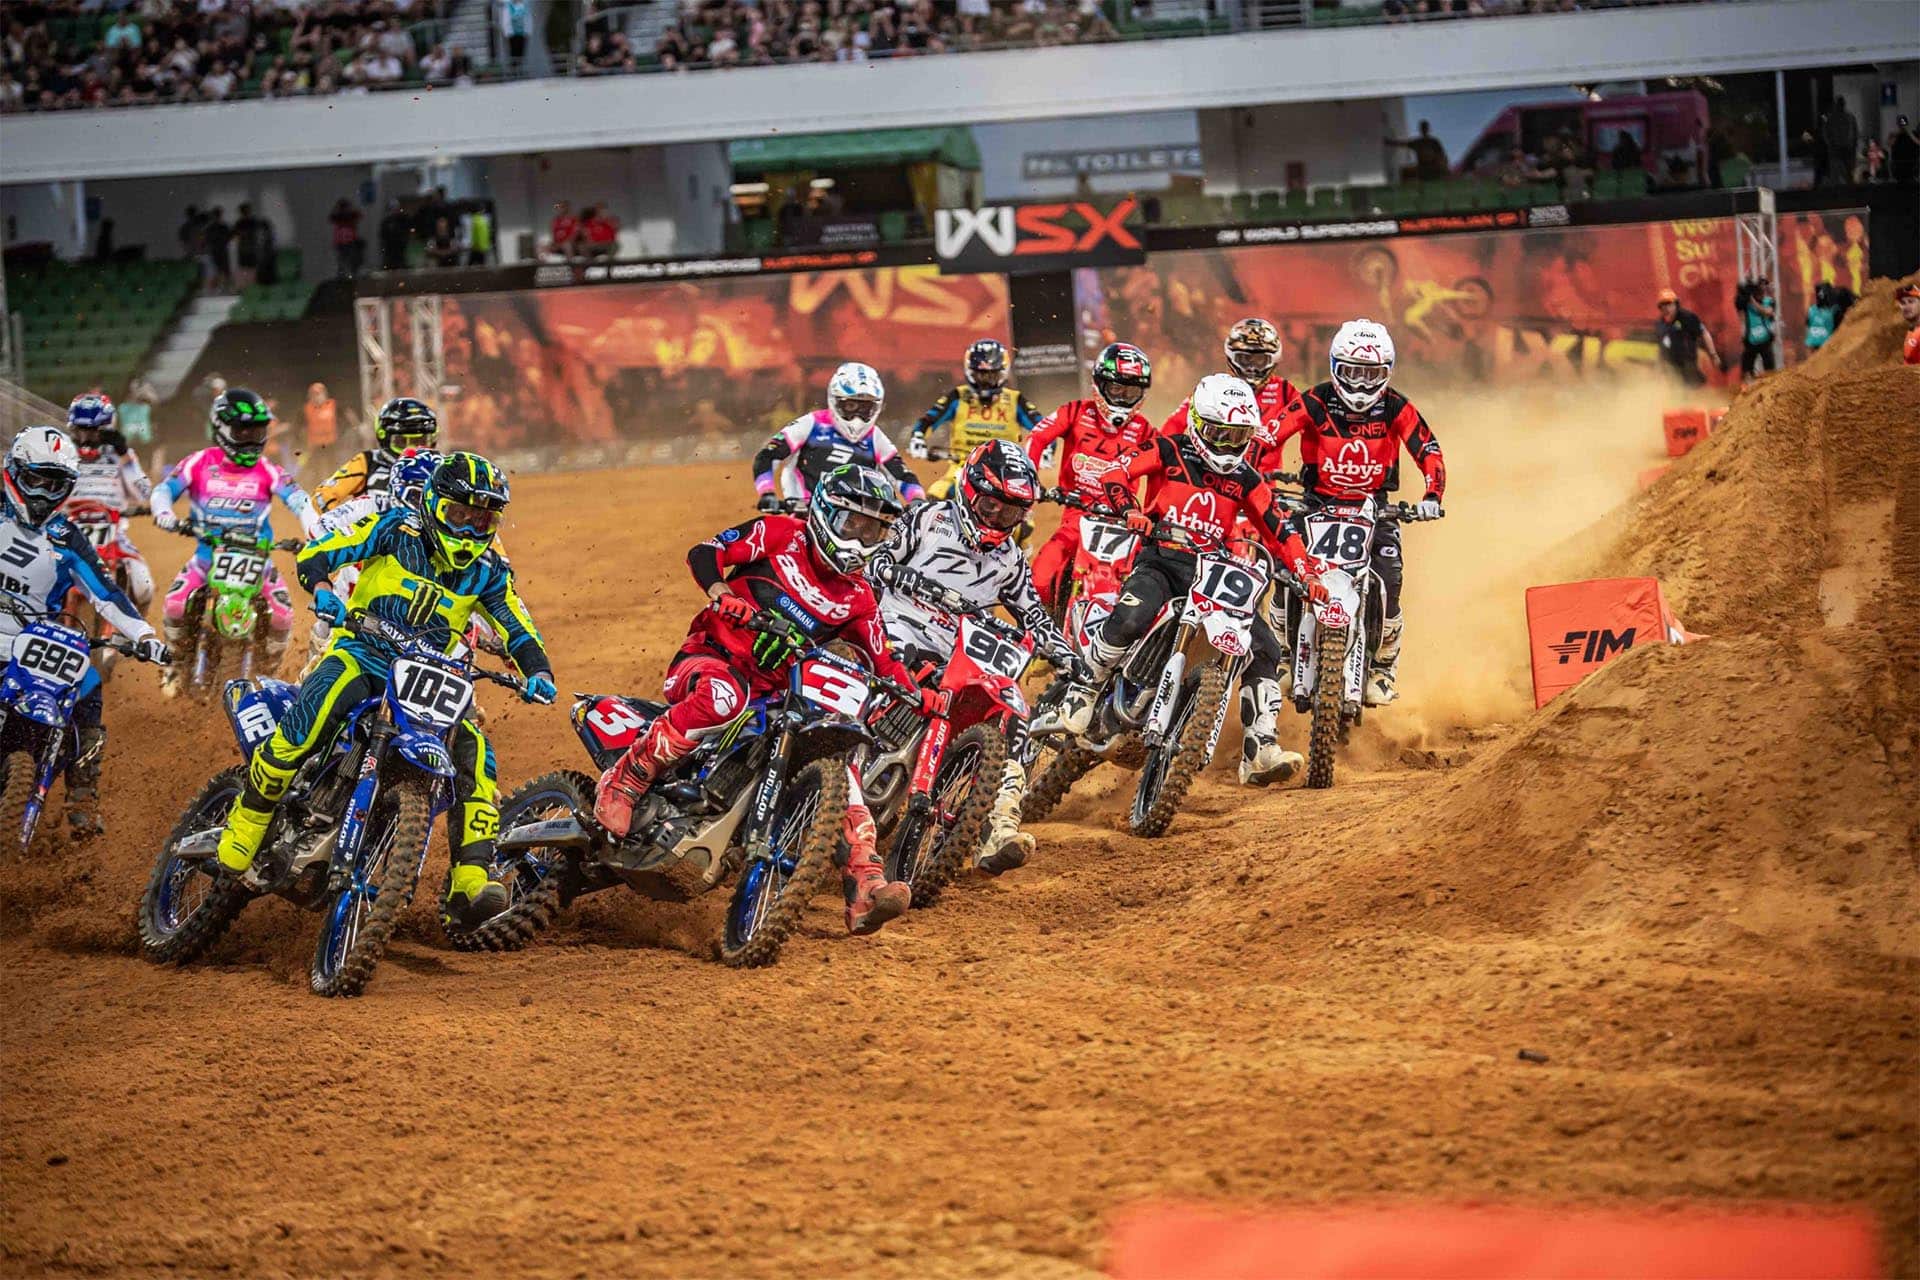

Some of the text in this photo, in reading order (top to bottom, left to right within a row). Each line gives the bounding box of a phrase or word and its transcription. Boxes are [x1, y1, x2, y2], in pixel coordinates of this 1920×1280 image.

[1076, 149, 1201, 170] TOILETS
[934, 199, 1142, 258] WSX
[967, 406, 1009, 423] FOX
[1321, 456, 1384, 479] Arby's
[1088, 525, 1131, 555] 17
[1164, 506, 1225, 540] Arby's
[1312, 523, 1367, 561] 48
[213, 555, 264, 586] 945
[1202, 563, 1254, 608] 19
[787, 602, 816, 631] YAMAHA
[19, 637, 85, 684] 692
[1547, 627, 1637, 665] FIM
[397, 664, 467, 719] 102
[802, 663, 869, 717] 3
[236, 702, 277, 743] 102
[586, 703, 646, 736] 3
[757, 767, 777, 822] DUNLOP
